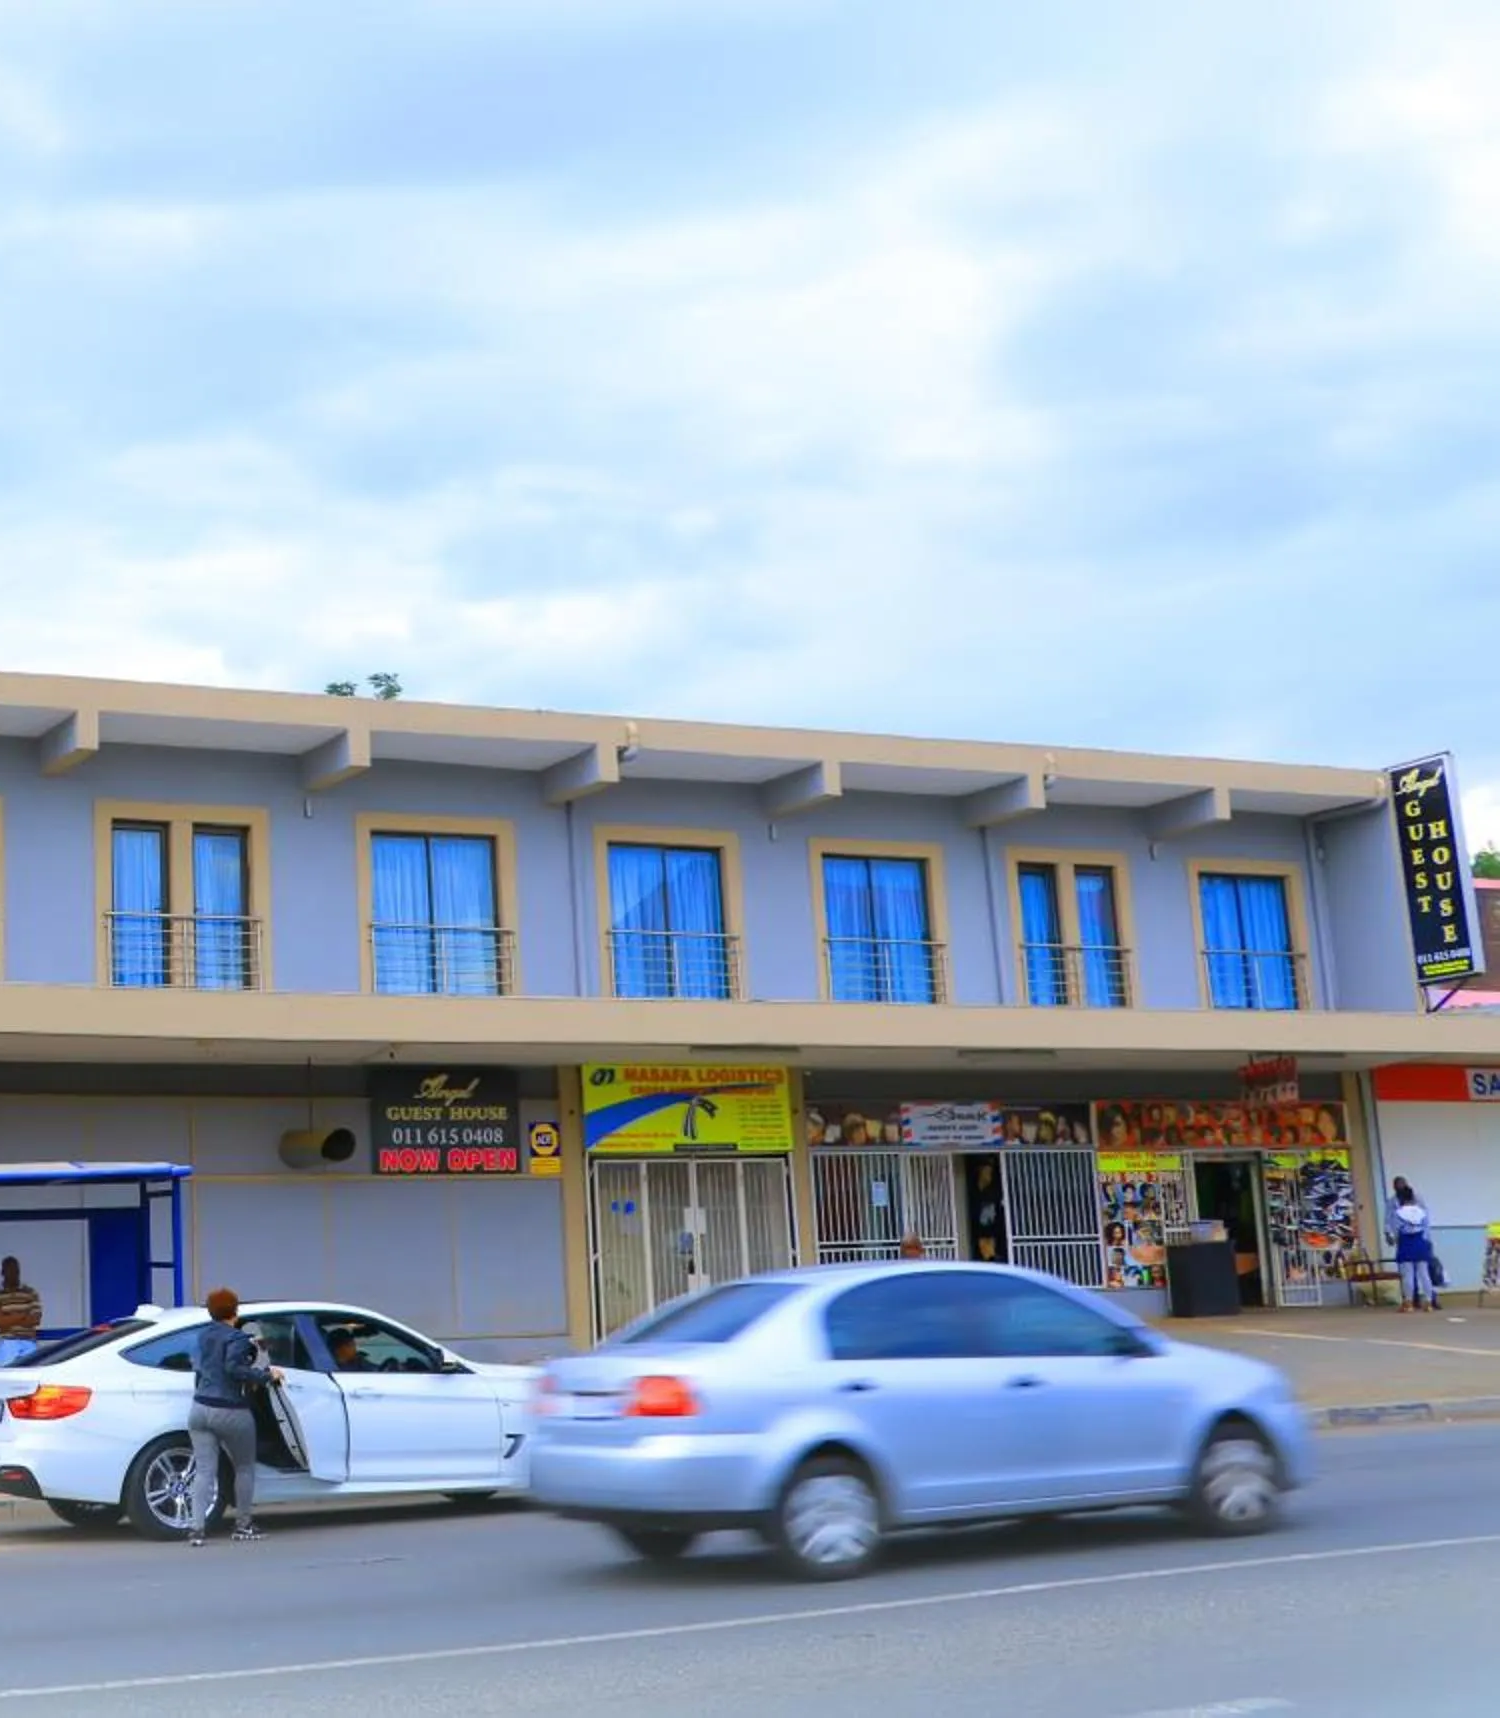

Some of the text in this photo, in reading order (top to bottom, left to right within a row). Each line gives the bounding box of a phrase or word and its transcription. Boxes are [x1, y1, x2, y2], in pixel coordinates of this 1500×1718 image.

[1404, 801, 1432, 913] GUEST
[1429, 820, 1458, 943] HOUSE
[386, 1107, 508, 1121] GUEST HOUSE
[392, 1127, 503, 1145] 011 615 0408
[379, 1148, 441, 1172] NOW
[447, 1148, 517, 1172] OPEN
